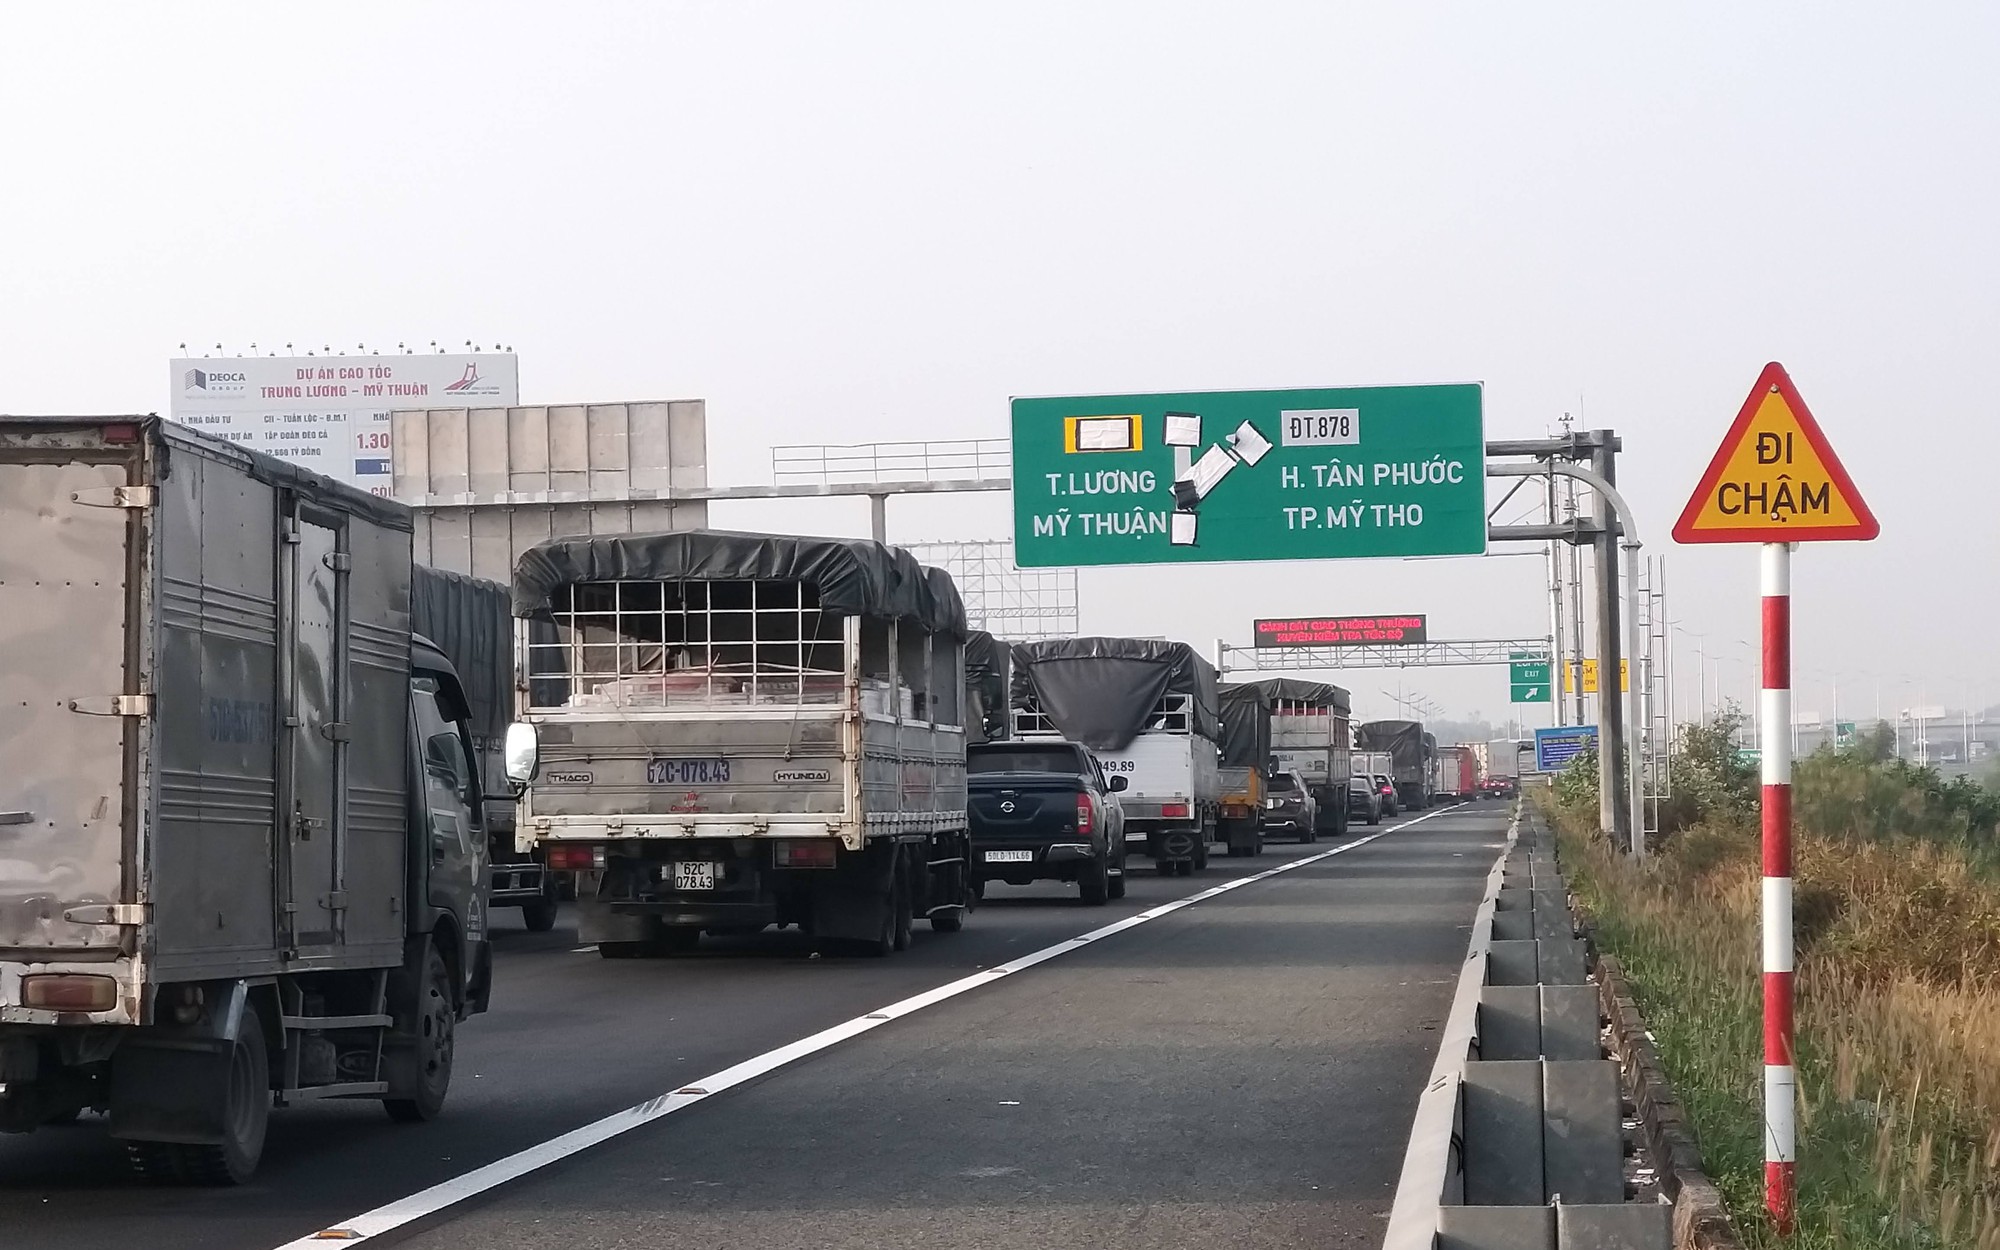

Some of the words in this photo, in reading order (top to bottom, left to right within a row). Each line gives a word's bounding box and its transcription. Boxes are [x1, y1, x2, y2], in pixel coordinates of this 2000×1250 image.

[209, 373, 246, 382] DEOCA
[296, 367, 313, 382] DỰ
[318, 366, 334, 380] ÁN
[339, 367, 364, 379] CAO
[368, 364, 392, 379] TỐC
[261, 386, 302, 398] TRUNG
[306, 385, 347, 397] LƯƠNG
[364, 382, 383, 396] MỸ
[387, 382, 428, 398] THUẬN
[1290, 416, 1350, 439] ĐT.878
[1756, 432, 1793, 464] ĐI
[1045, 469, 1156, 496] T.LƯƠNG
[1282, 465, 1305, 489] H.
[1312, 458, 1364, 487] TÂN
[1374, 454, 1464, 486] PHƯỚC
[1718, 473, 1830, 523] CHẬM
[1034, 507, 1072, 537] MỸ
[1078, 506, 1167, 540] THUẬN
[1370, 504, 1423, 527] THO
[551, 774, 590, 782] THACO
[647, 760, 731, 783] 62C-078.43
[777, 772, 827, 780] HYUNDAI
[683, 863, 705, 876] 62C
[676, 876, 713, 889] 078.43
